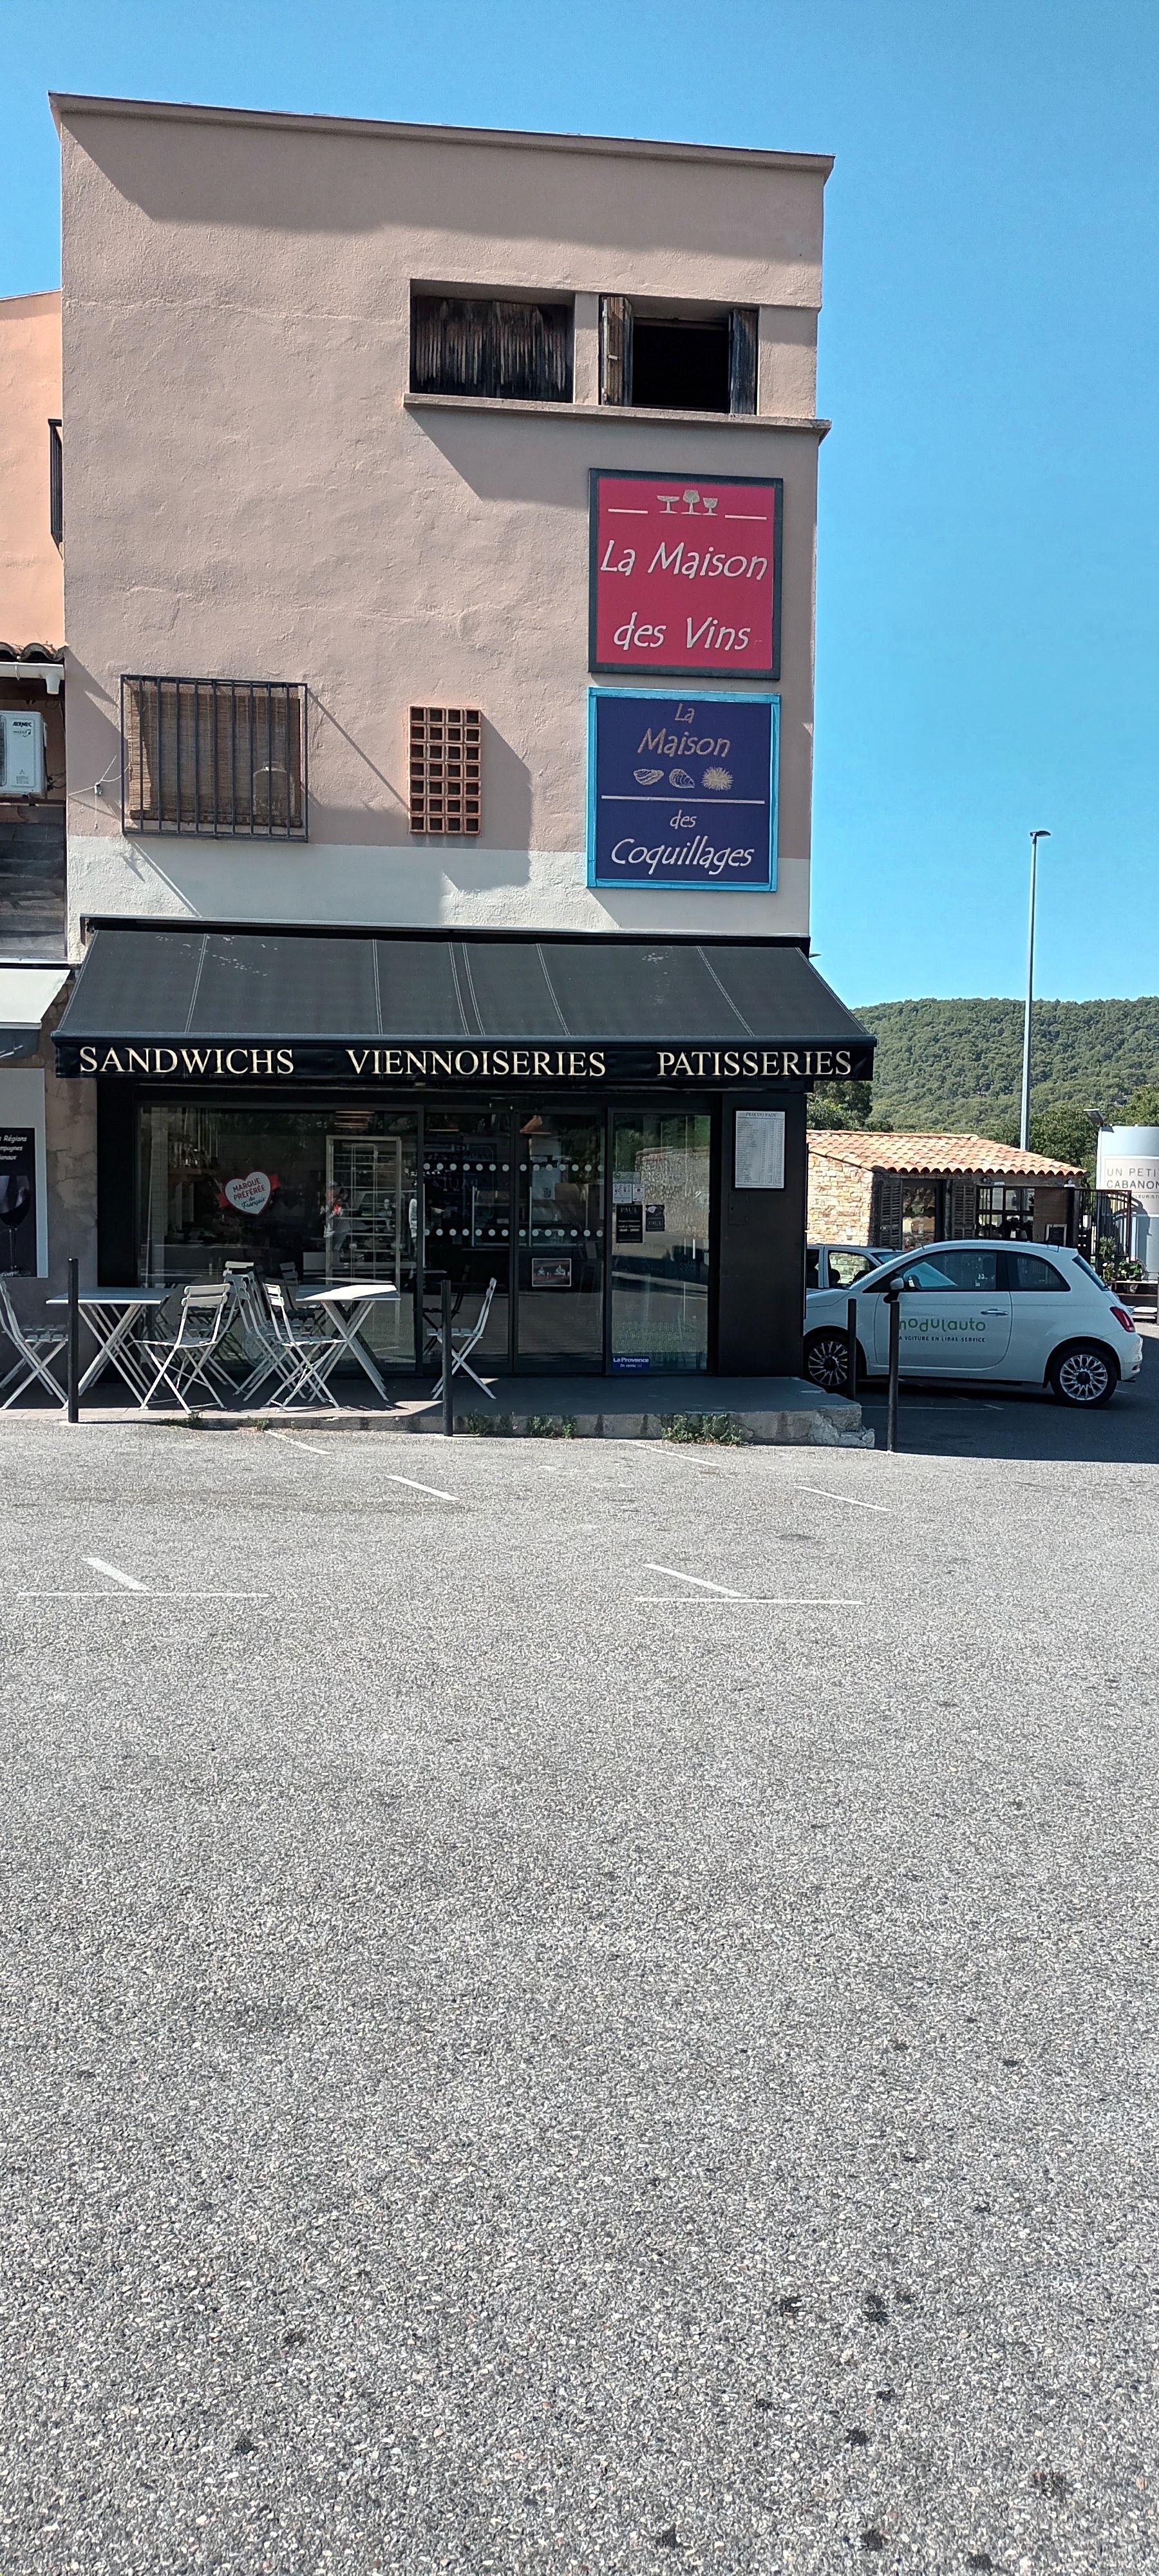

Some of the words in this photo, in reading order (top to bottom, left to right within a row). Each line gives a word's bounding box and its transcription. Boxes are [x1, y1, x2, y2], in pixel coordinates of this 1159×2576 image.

[601, 540, 636, 576] La
[648, 542, 768, 580] Maison
[614, 612, 666, 650] des
[686, 617, 751, 651] Vins
[674, 703, 695, 723] La
[638, 728, 730, 757] Maison
[670, 810, 697, 828] des
[610, 835, 754, 875] Coquillages
[80, 1046, 294, 1074] SANDWICHS
[345, 1050, 606, 1077] VIENNOISERIES
[657, 1051, 851, 1076] PATISSERIES
[232, 1178, 261, 1193] MARQUE
[1107, 1168, 1122, 1177] UN
[1129, 1168, 1159, 1177] PETI
